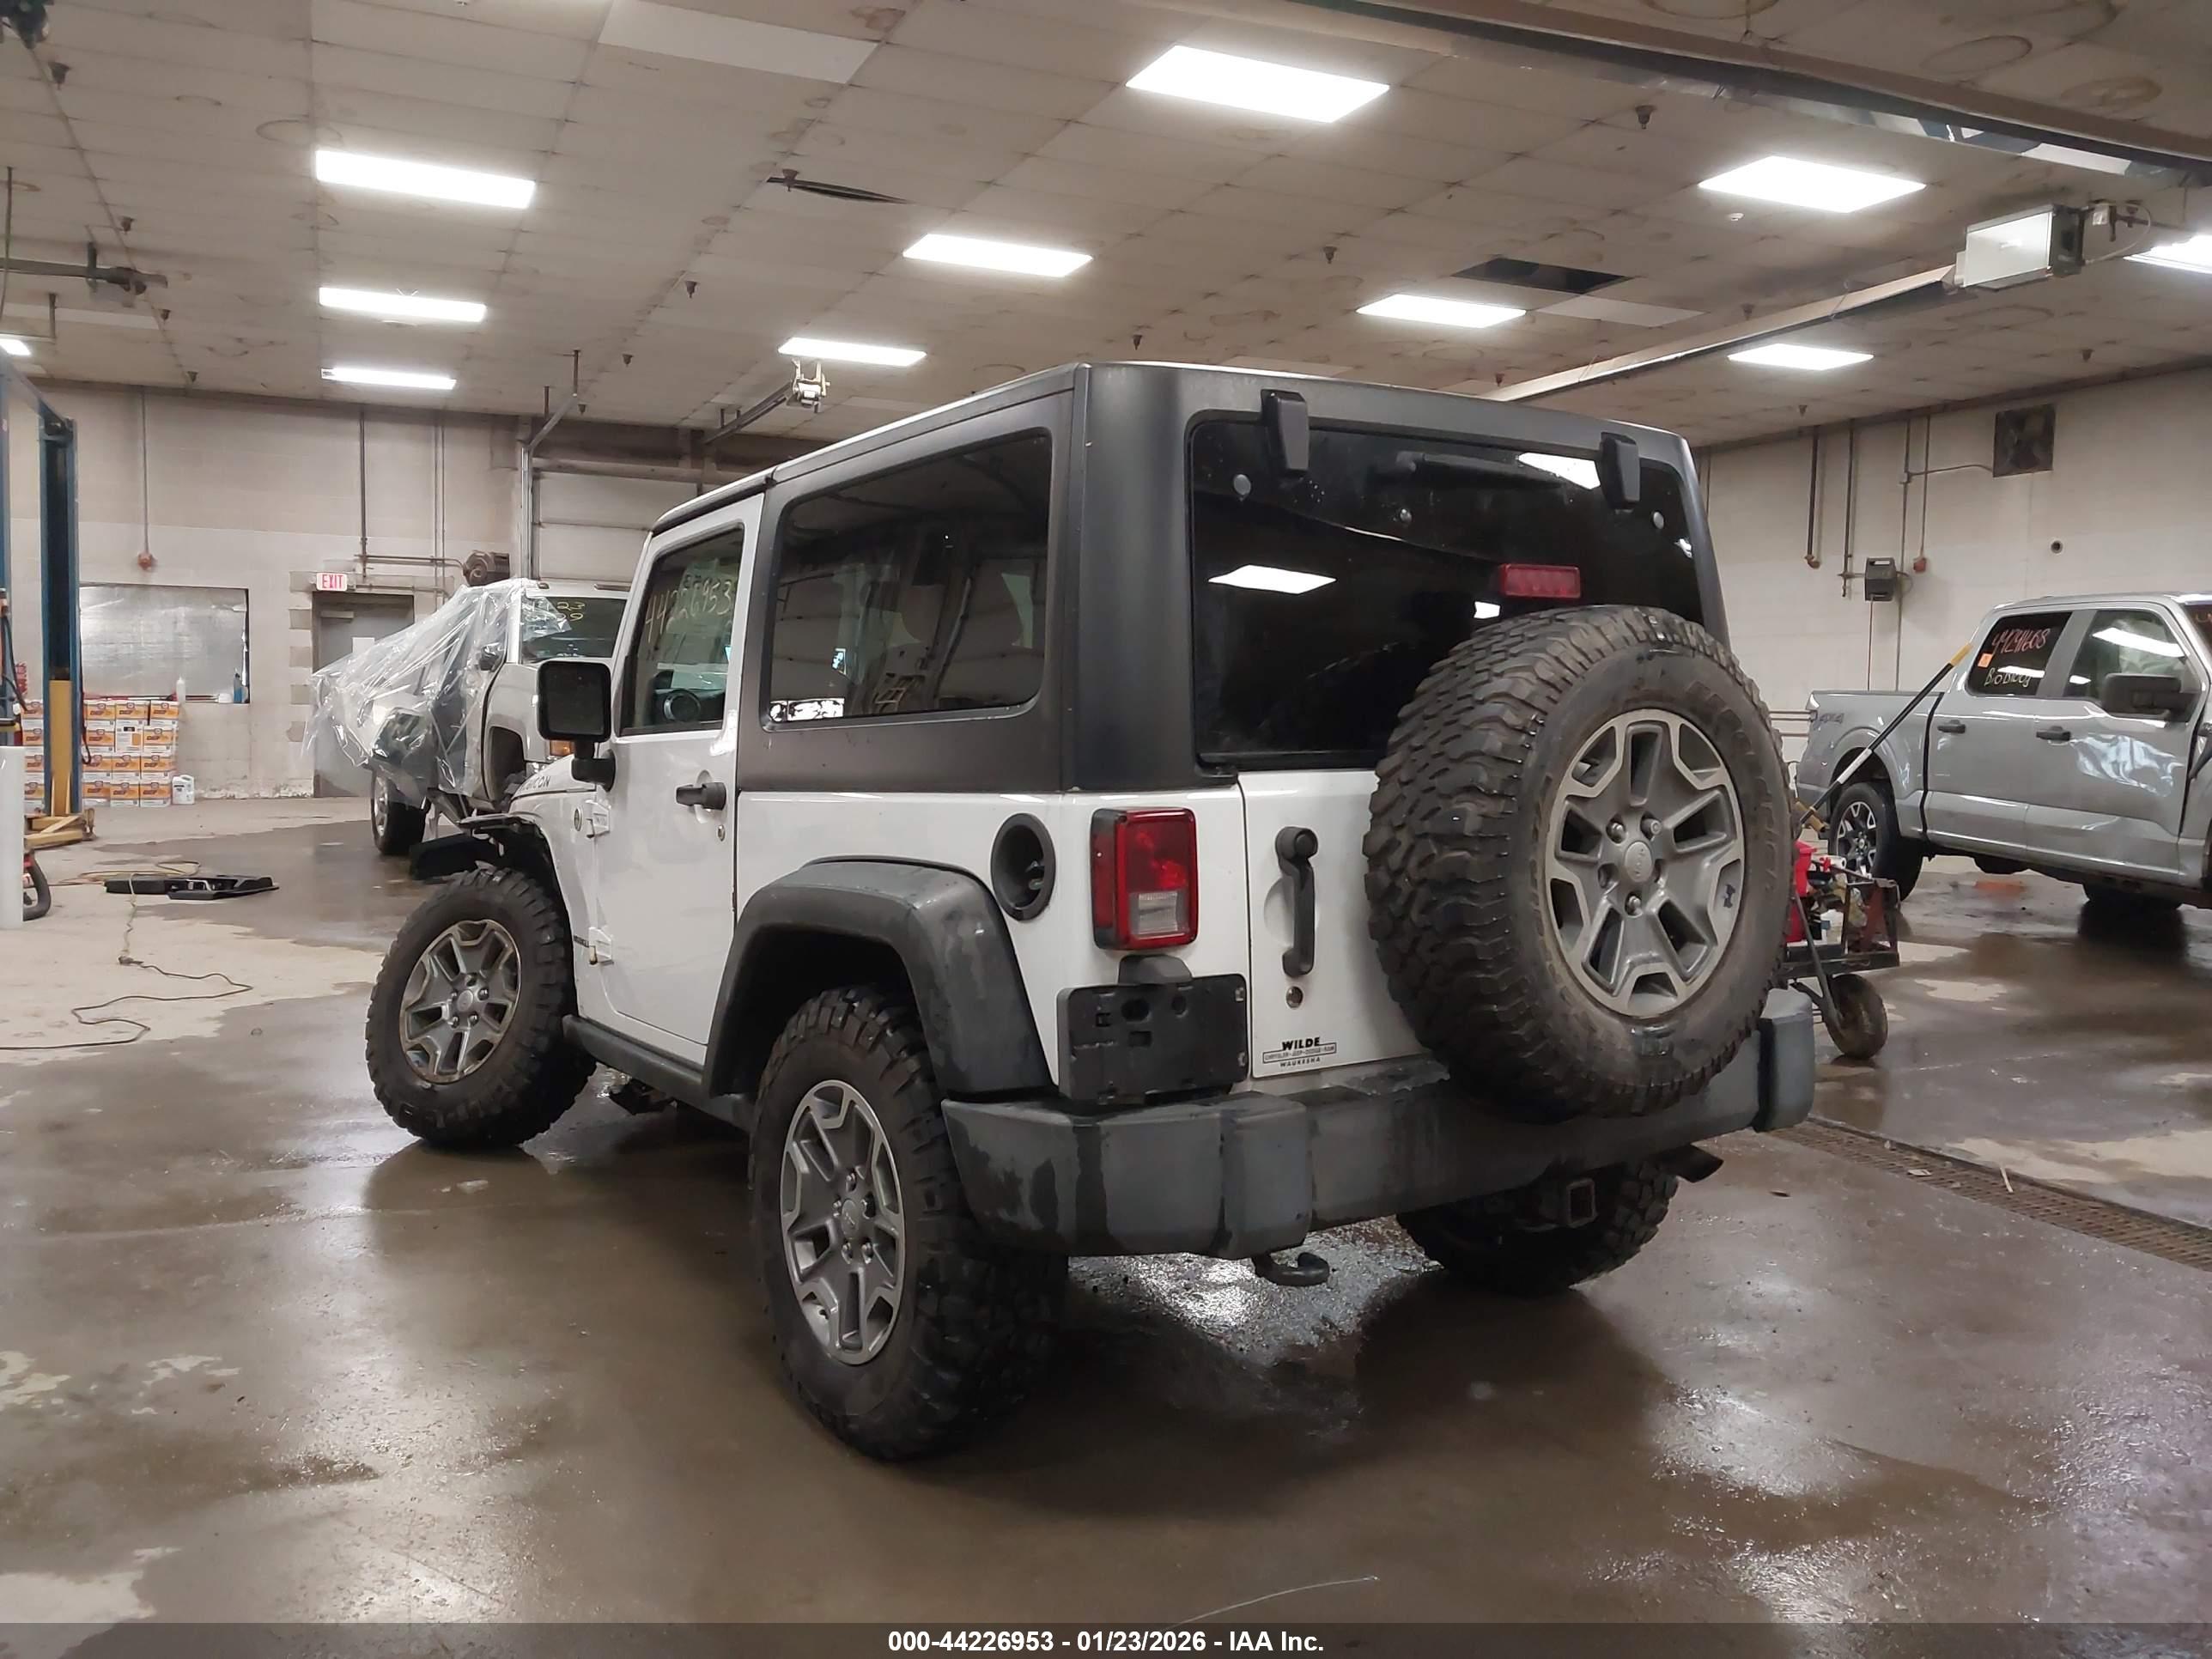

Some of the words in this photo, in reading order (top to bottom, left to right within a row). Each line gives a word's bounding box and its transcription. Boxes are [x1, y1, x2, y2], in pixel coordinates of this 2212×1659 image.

[321, 574, 344, 589] EXIT
[1282, 1037, 1320, 1050] WILDE
[1280, 1056, 1321, 1067] WAUKESHA
